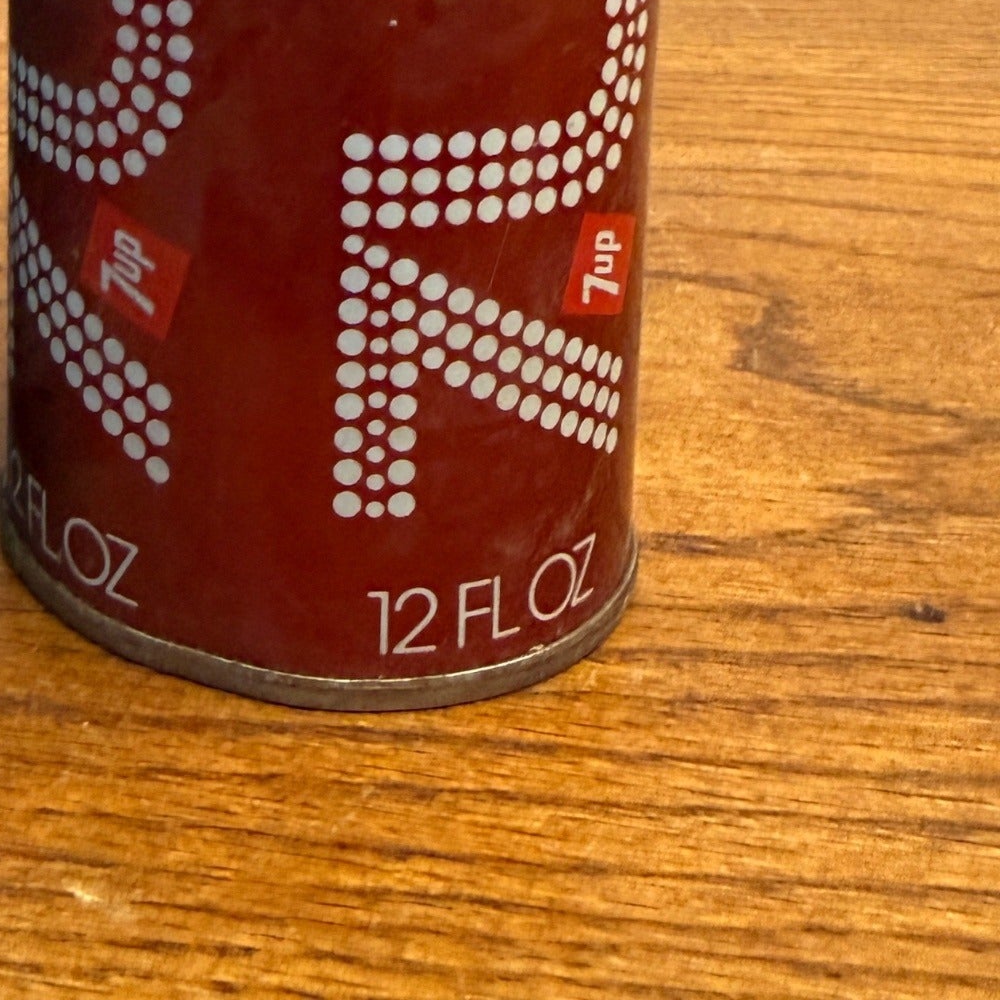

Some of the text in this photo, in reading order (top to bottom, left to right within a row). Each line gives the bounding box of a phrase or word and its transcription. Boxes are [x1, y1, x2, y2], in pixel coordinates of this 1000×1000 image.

[99, 228, 156, 317] 7up
[581, 229, 623, 306] 7up
[63, 516, 139, 608] OZ
[366, 532, 597, 656] 12 FL OZ
